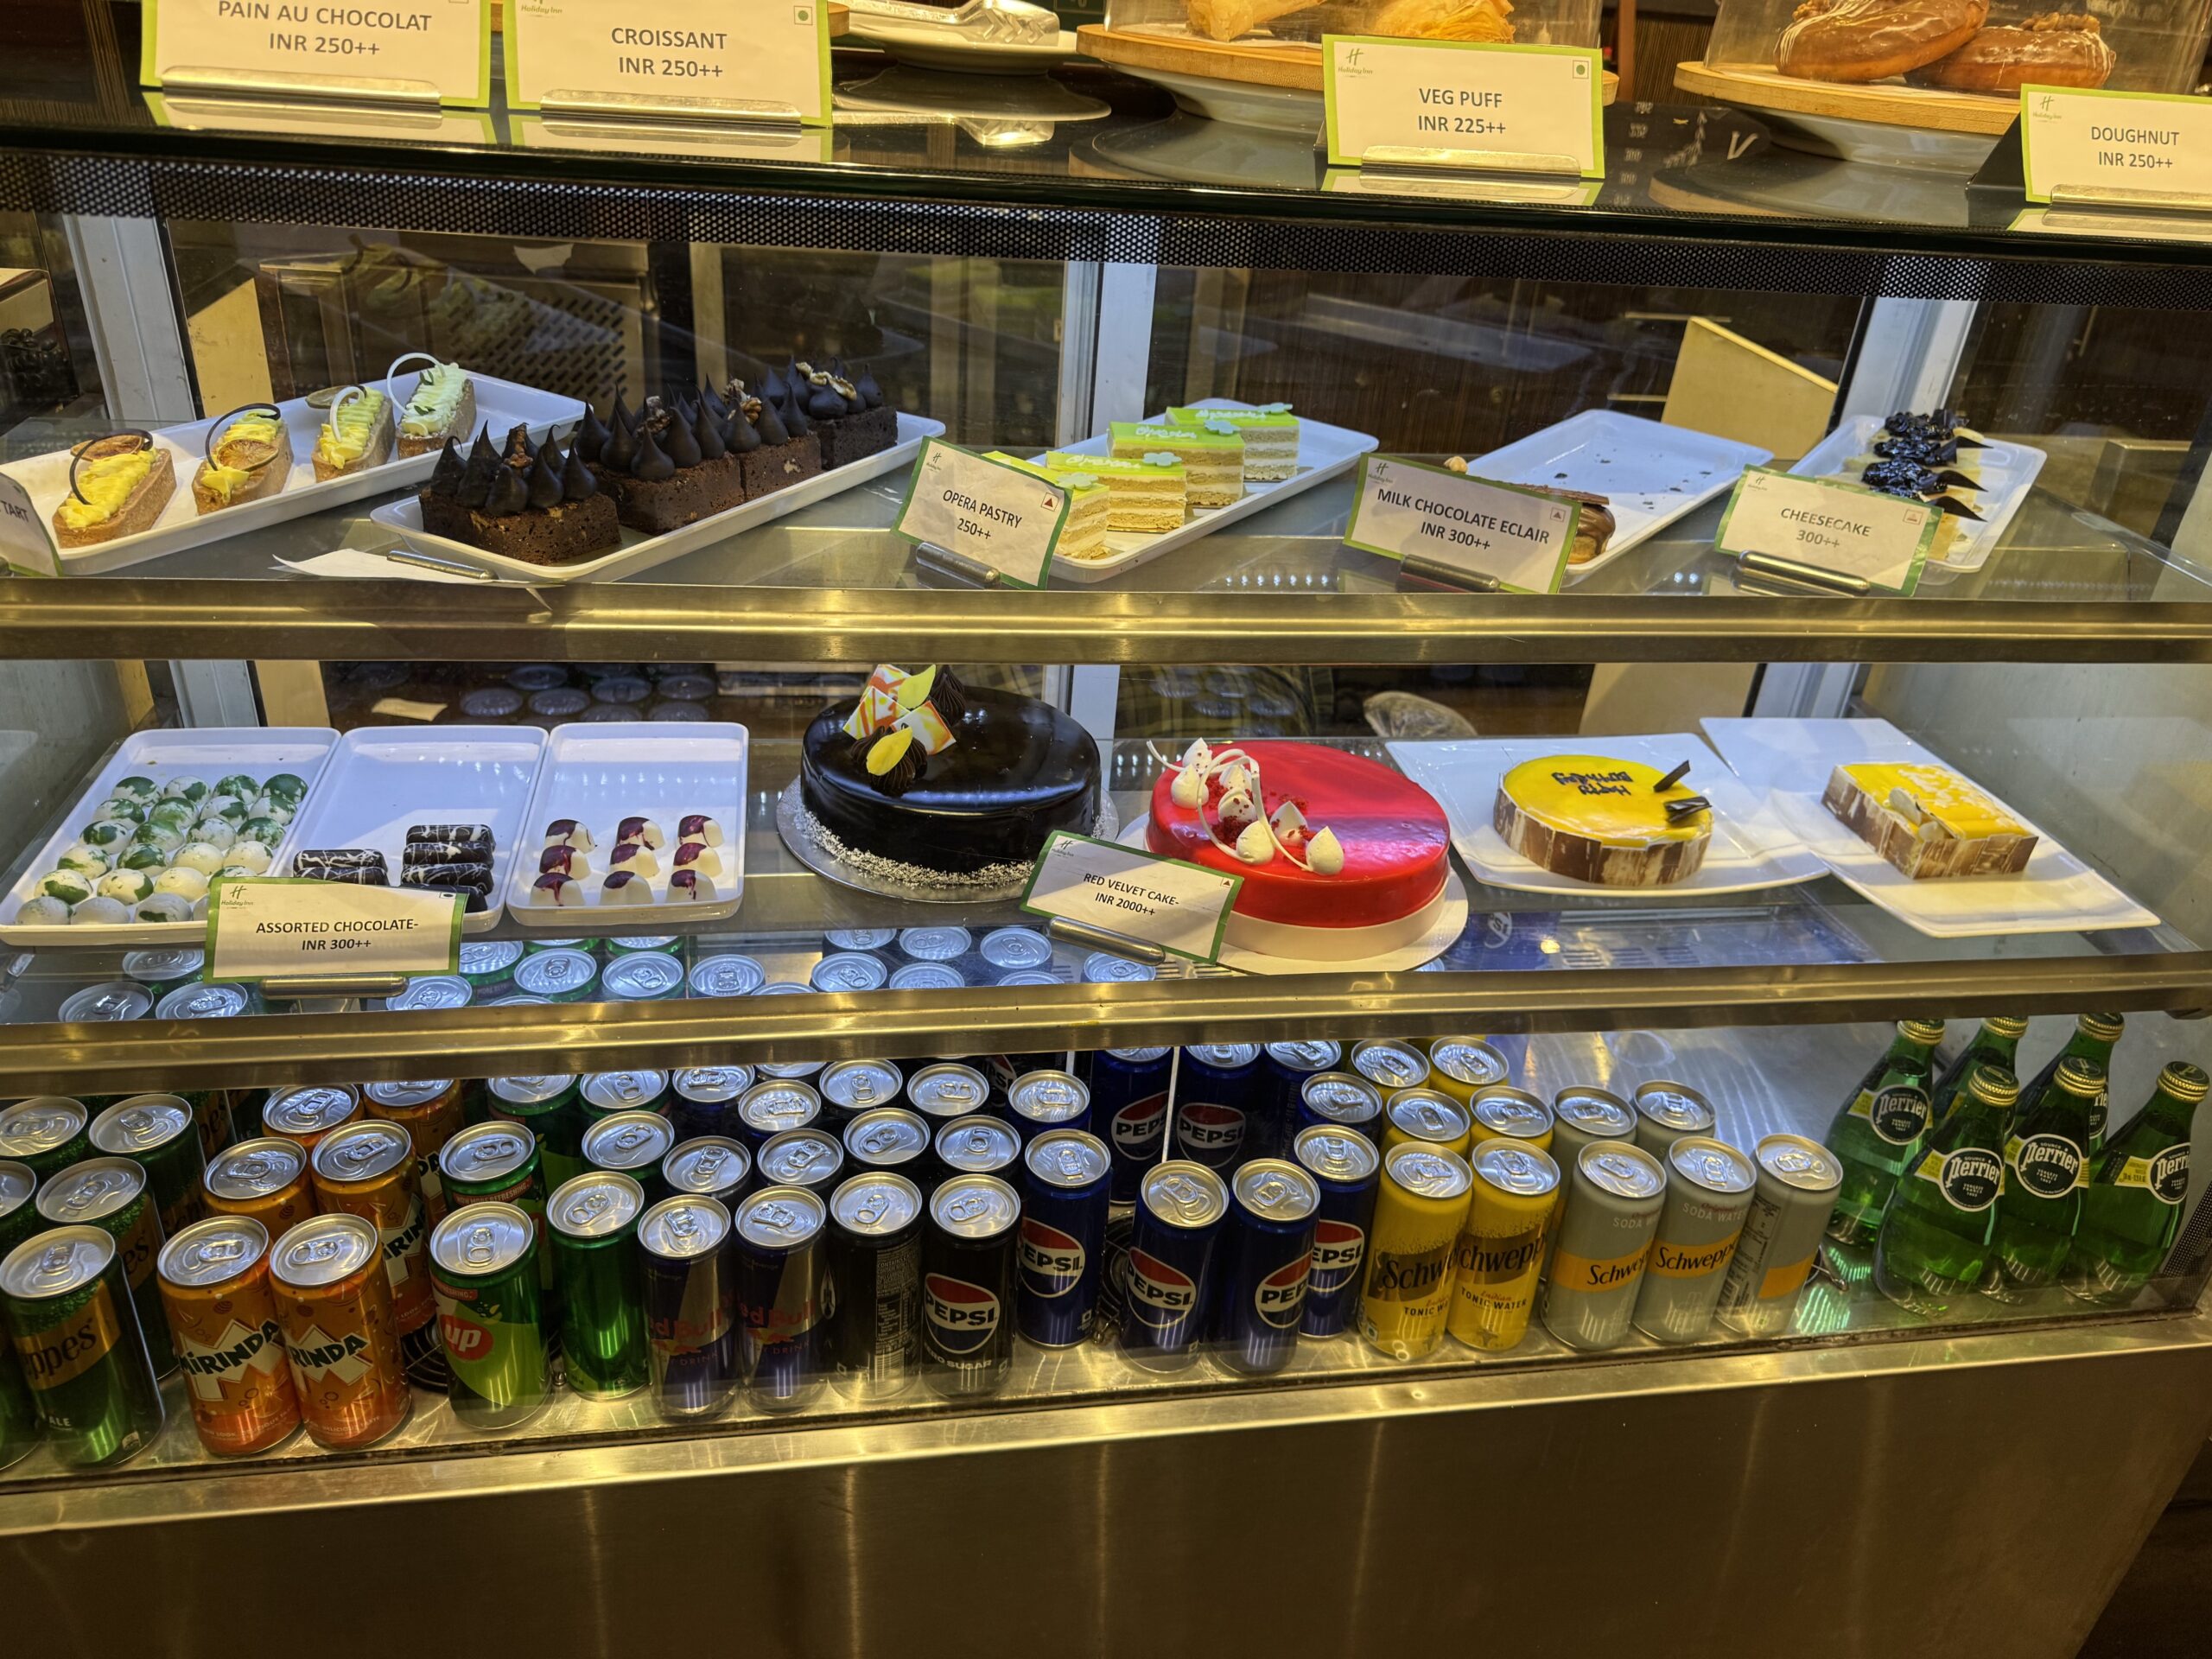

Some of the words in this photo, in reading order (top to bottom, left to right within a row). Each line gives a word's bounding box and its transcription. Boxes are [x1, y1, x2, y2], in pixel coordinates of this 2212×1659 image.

[219, 1, 269, 19] PAIN
[276, 5, 308, 22] AU
[316, 8, 432, 31] CHOCOLAT
[270, 33, 308, 51] INR
[315, 36, 380, 54] 250++
[611, 28, 728, 49] CROISSANT
[619, 57, 655, 74] INR
[662, 59, 723, 77] 250++
[1419, 88, 1454, 105] VEG
[1460, 91, 1503, 108] PUFF
[1419, 115, 1449, 131] INR
[1454, 118, 1506, 134] 225++
[2091, 126, 2180, 145] DOUGHNUT
[2099, 151, 2125, 167] INR
[2129, 154, 2173, 168] 250++
[1, 500, 29, 523] TART
[943, 489, 976, 512] OPERA
[979, 503, 1022, 529] PASTRY
[1377, 488, 1413, 508] MILK
[1414, 498, 1497, 530] CHOCOLATE
[1500, 520, 1550, 544] ECLAIR
[957, 518, 991, 540] 250++
[1780, 507, 1872, 537] CHEESECAKE
[1421, 521, 1446, 539] INR
[1448, 529, 1491, 550] 300++
[1796, 529, 1840, 549] 300++
[1084, 873, 1105, 887] RED
[1108, 879, 1147, 897] VELVET
[1095, 892, 1114, 906] INR
[1116, 897, 1156, 916] 2000++
[256, 921, 330, 934] ASSORTED
[302, 939, 327, 950] INR
[330, 938, 372, 950] 300++
[1179, 1117, 1243, 1143] PEPSI
[1461, 1286, 1491, 1308] TONIC
[1493, 1299, 1527, 1310] WATER
[1404, 1306, 1434, 1317] TONIC
[945, 1358, 992, 1370] SUGAR
